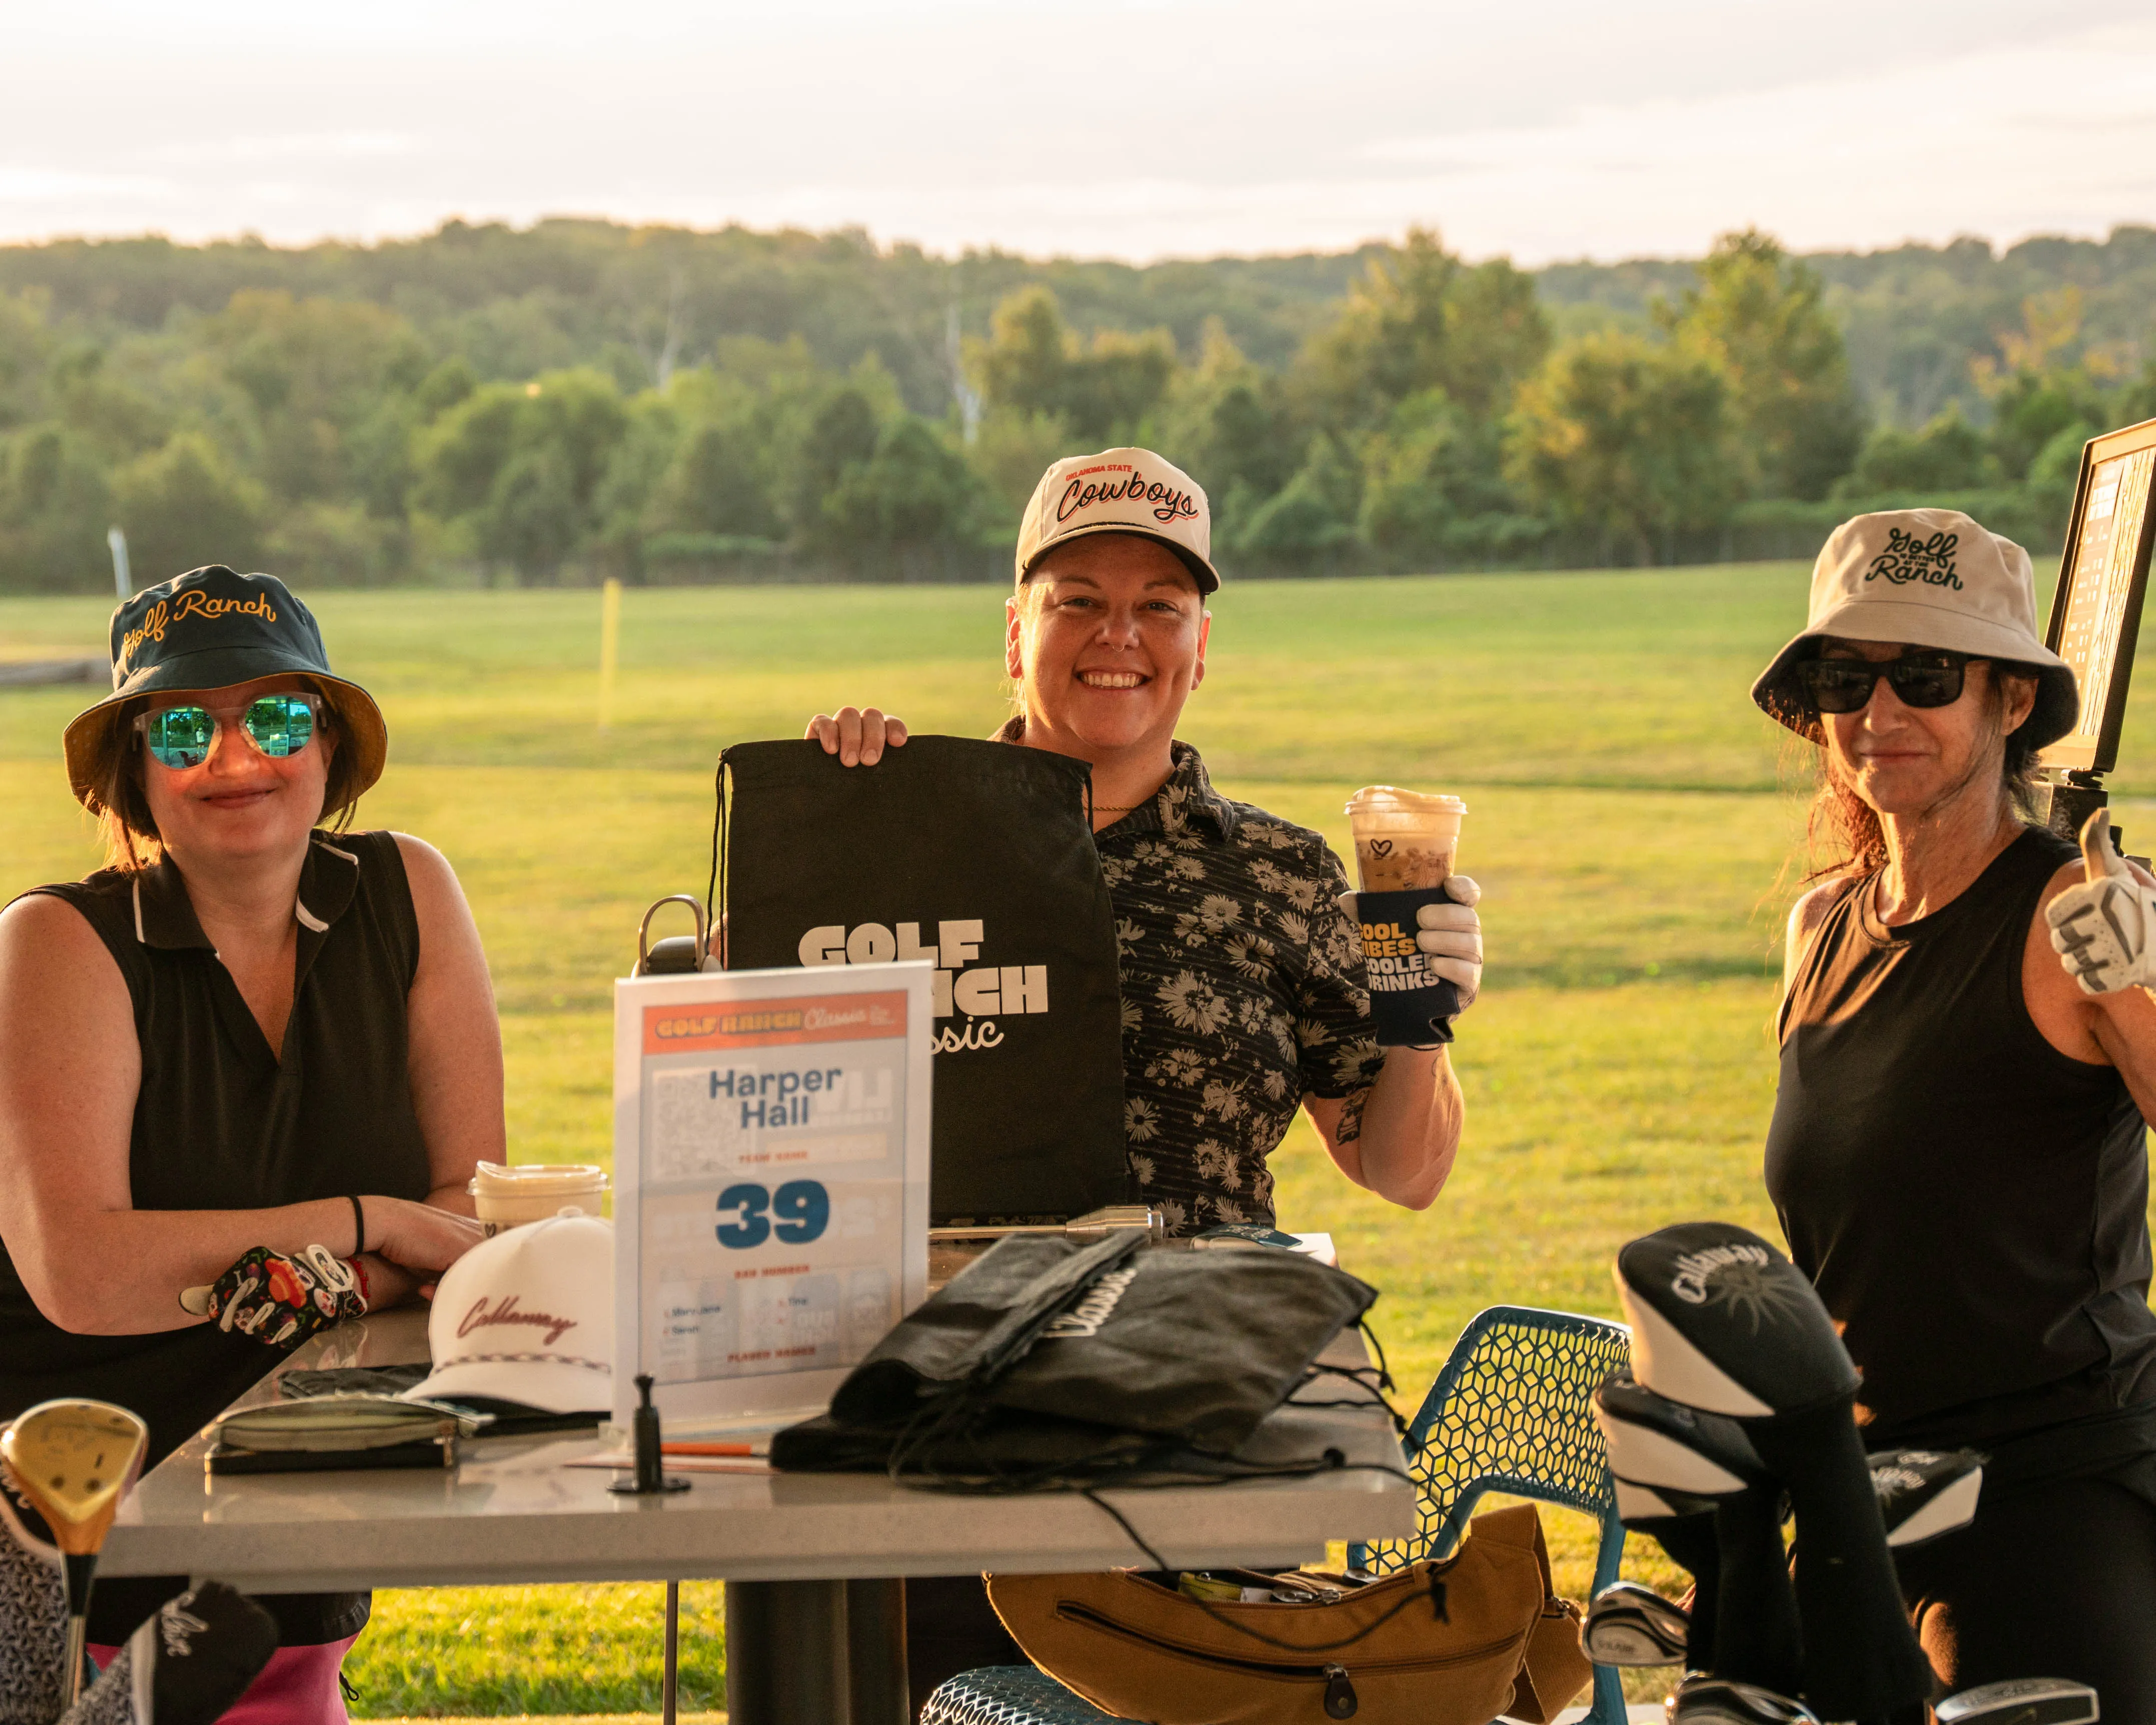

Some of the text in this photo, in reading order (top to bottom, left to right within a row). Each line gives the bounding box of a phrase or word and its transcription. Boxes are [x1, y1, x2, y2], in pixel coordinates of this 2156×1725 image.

[1065, 464, 1132, 481] OKLAHOMA STATE
[1057, 471, 1200, 524] Cowboys
[1883, 527, 1958, 568] Golf
[1865, 554, 1963, 590] Ranch
[123, 589, 277, 658] Golf Ranch
[798, 920, 984, 968] GOLF
[1363, 939, 1416, 957] IBES
[1365, 954, 1432, 975] OOLE
[709, 1068, 843, 1101] Harper
[740, 1096, 809, 1129] Hall
[714, 1179, 829, 1250] 39
